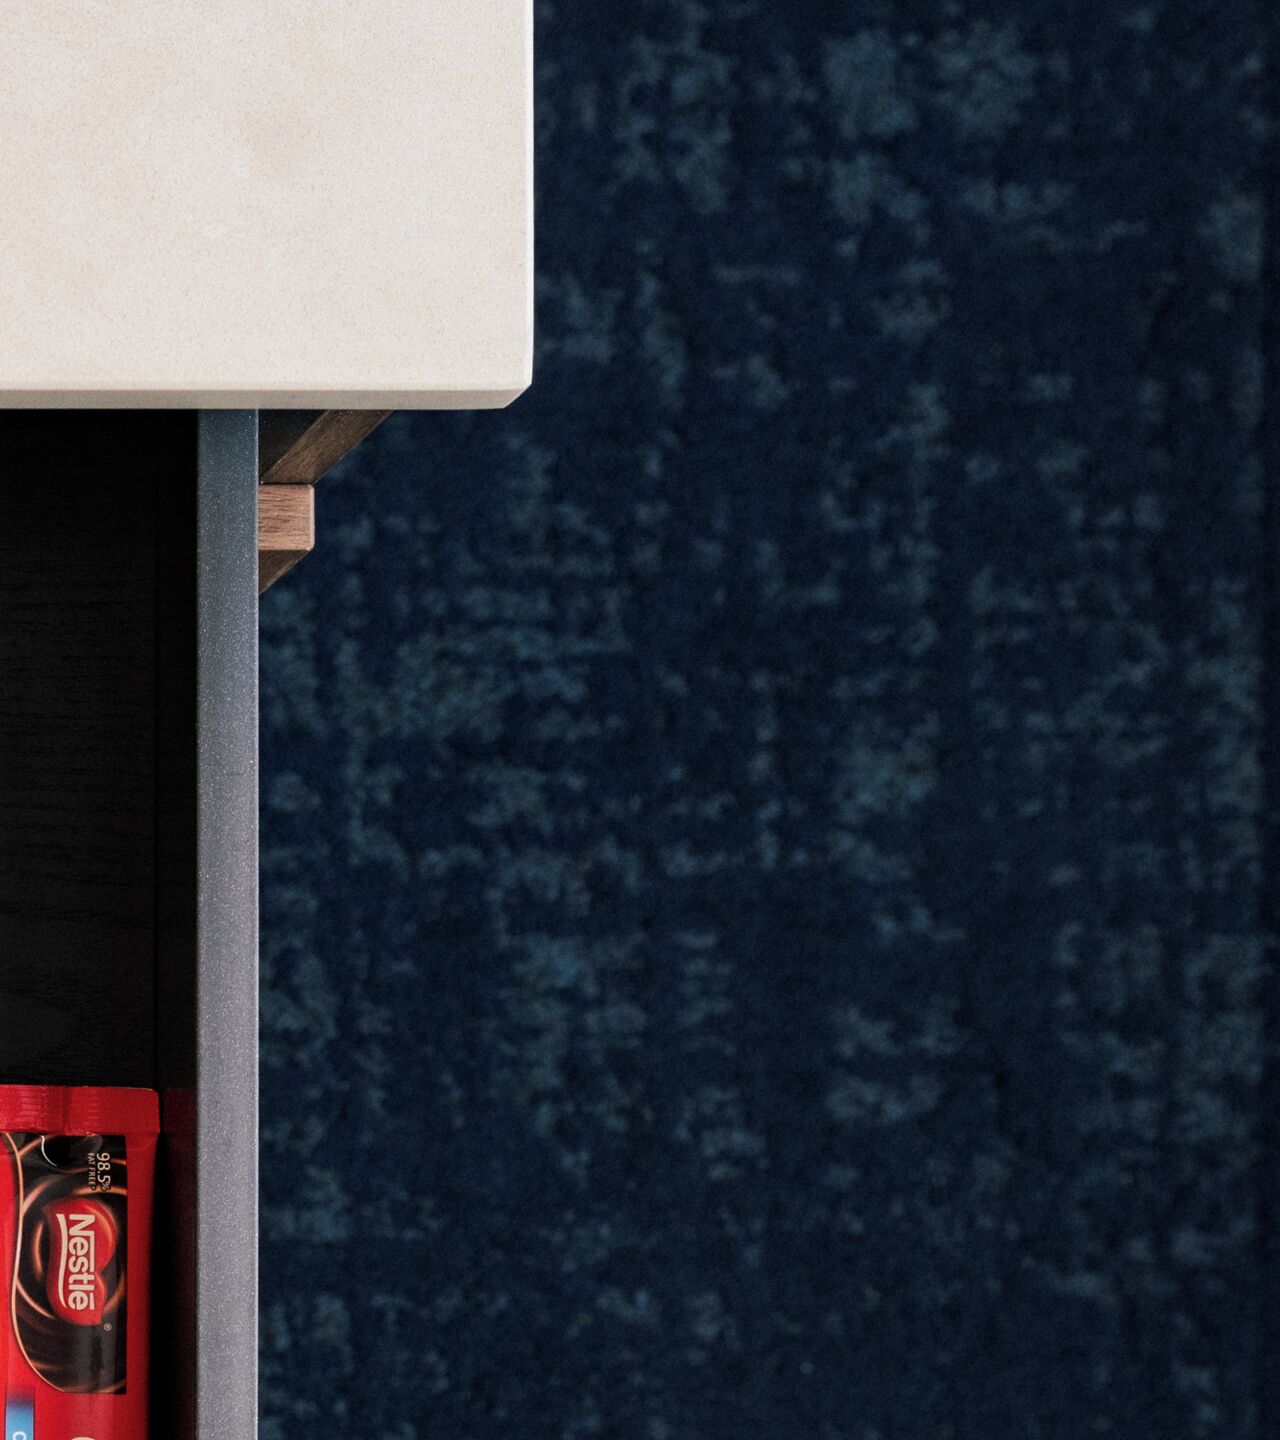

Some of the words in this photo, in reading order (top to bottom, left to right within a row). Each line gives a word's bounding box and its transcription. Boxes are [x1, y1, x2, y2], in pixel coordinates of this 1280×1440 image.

[87, 1152, 96, 1165] FAT
[96, 1152, 111, 1192] 98.5%
[67, 1214, 96, 1310] Nestlé
